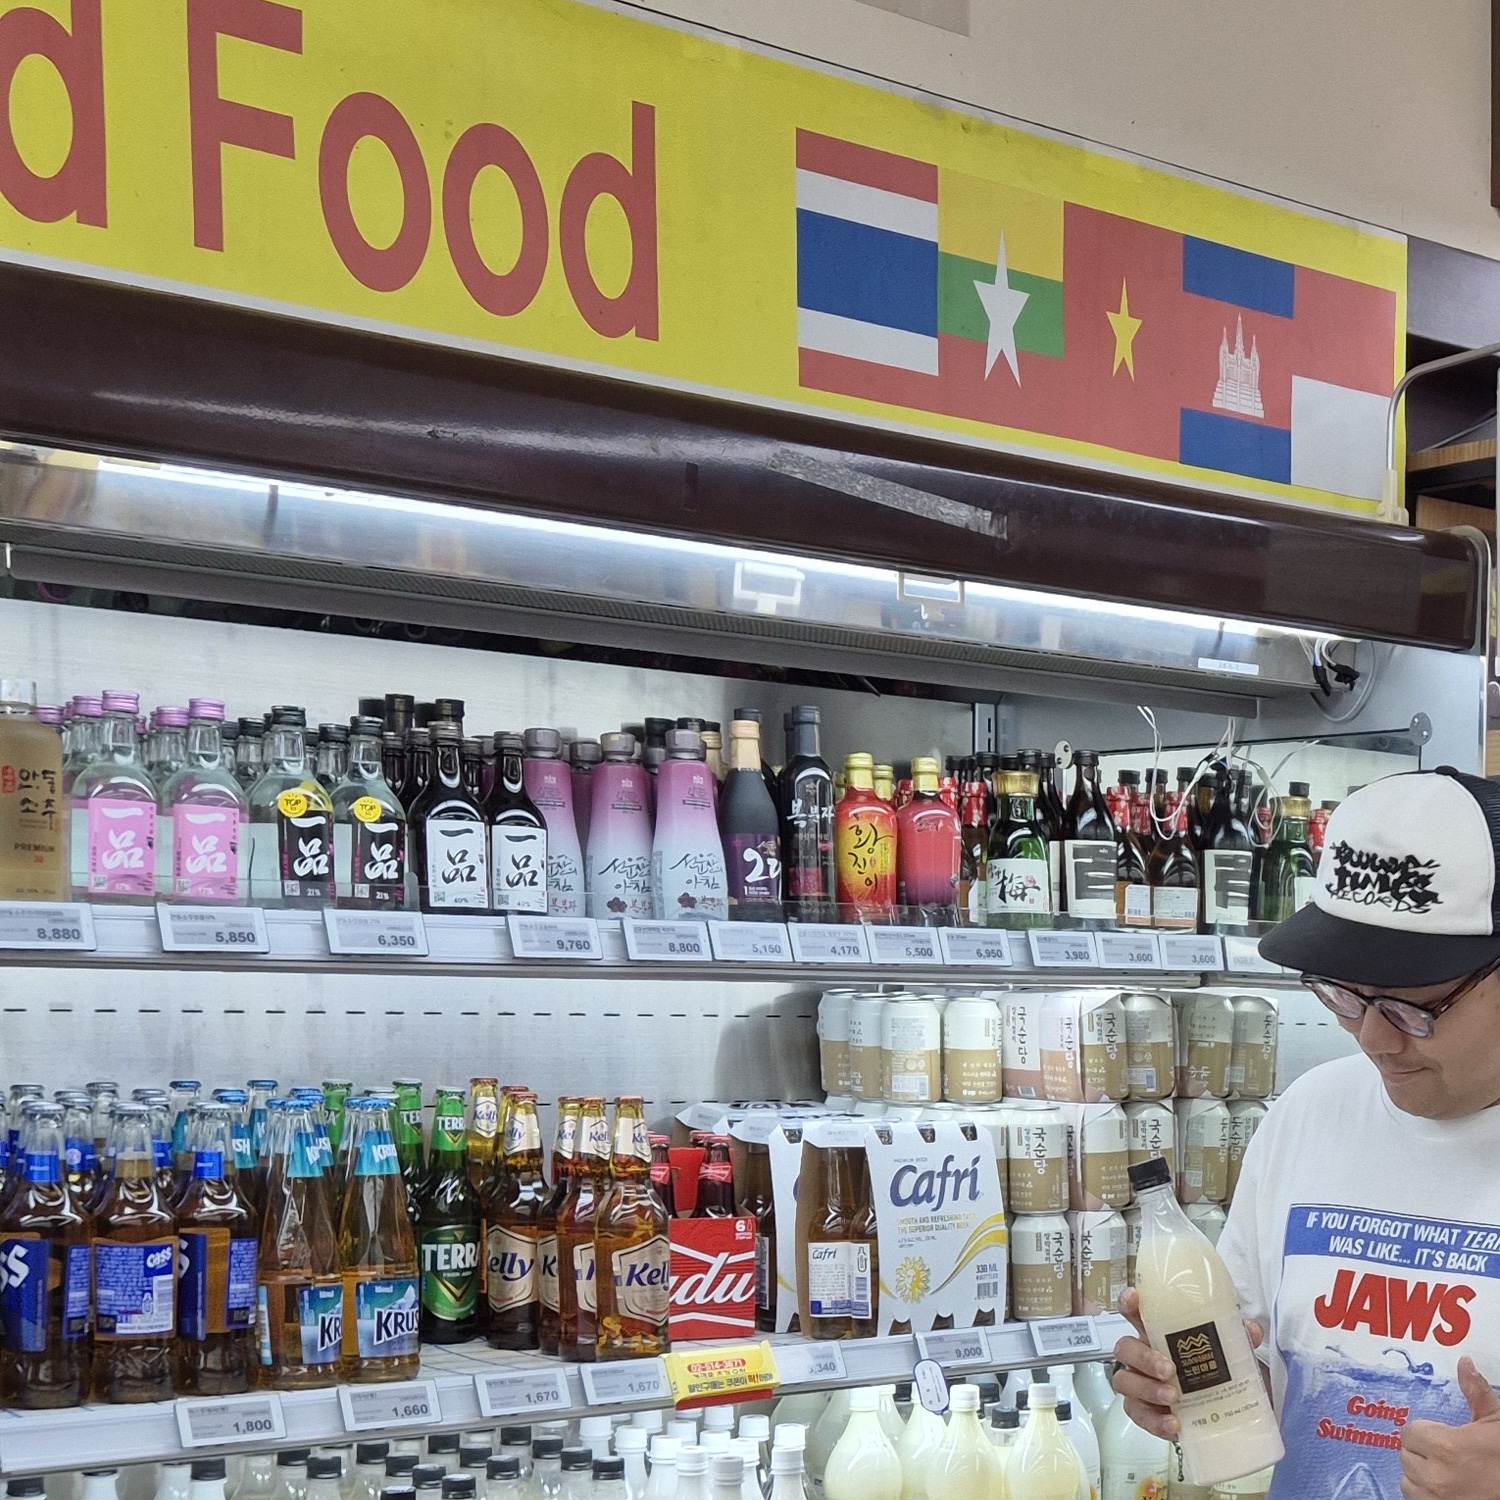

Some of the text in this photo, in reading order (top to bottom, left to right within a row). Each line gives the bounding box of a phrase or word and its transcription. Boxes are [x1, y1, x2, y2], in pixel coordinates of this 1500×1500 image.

[187, 0, 660, 342] Food
[18, 768, 57, 795] 안동
[37, 927, 81, 942] 8,880
[215, 930, 256, 944] 5,850
[377, 933, 416, 948] 6,350
[556, 939, 592, 952] 9,760
[668, 941, 701, 954] 8,800
[751, 943, 782, 955] 5,150
[829, 945, 860, 957] 4,170
[905, 946, 934, 958] 5,500
[976, 947, 1003, 960] 6,950
[1064, 949, 1091, 961] 3,980
[1128, 952, 1154, 963] 3,600
[1033, 1127, 1048, 1175] 국순당
[889, 1154, 981, 1212] Cafri
[1306, 1211, 1319, 1229] IF
[1320, 1213, 1350, 1231] YOU
[1350, 1215, 1411, 1242] FORGOT
[1413, 1225, 1461, 1247] WHAT
[812, 1247, 838, 1261] Cafri
[1329, 1235, 1489, 1274] WAS LIKE... IT'S BACK
[1314, 1268, 1478, 1348] JAWS
[373, 1305, 419, 1347] KRUS
[1066, 1334, 1092, 1347] 1,200
[954, 1346, 983, 1359] 9,000
[627, 1378, 660, 1393] 1,670
[525, 1390, 559, 1405] 1,670
[391, 1403, 429, 1418] 1,660
[1346, 1394, 1410, 1427] Going
[233, 1418, 273, 1434] 1,800
[1316, 1417, 1405, 1450] Swimmi
